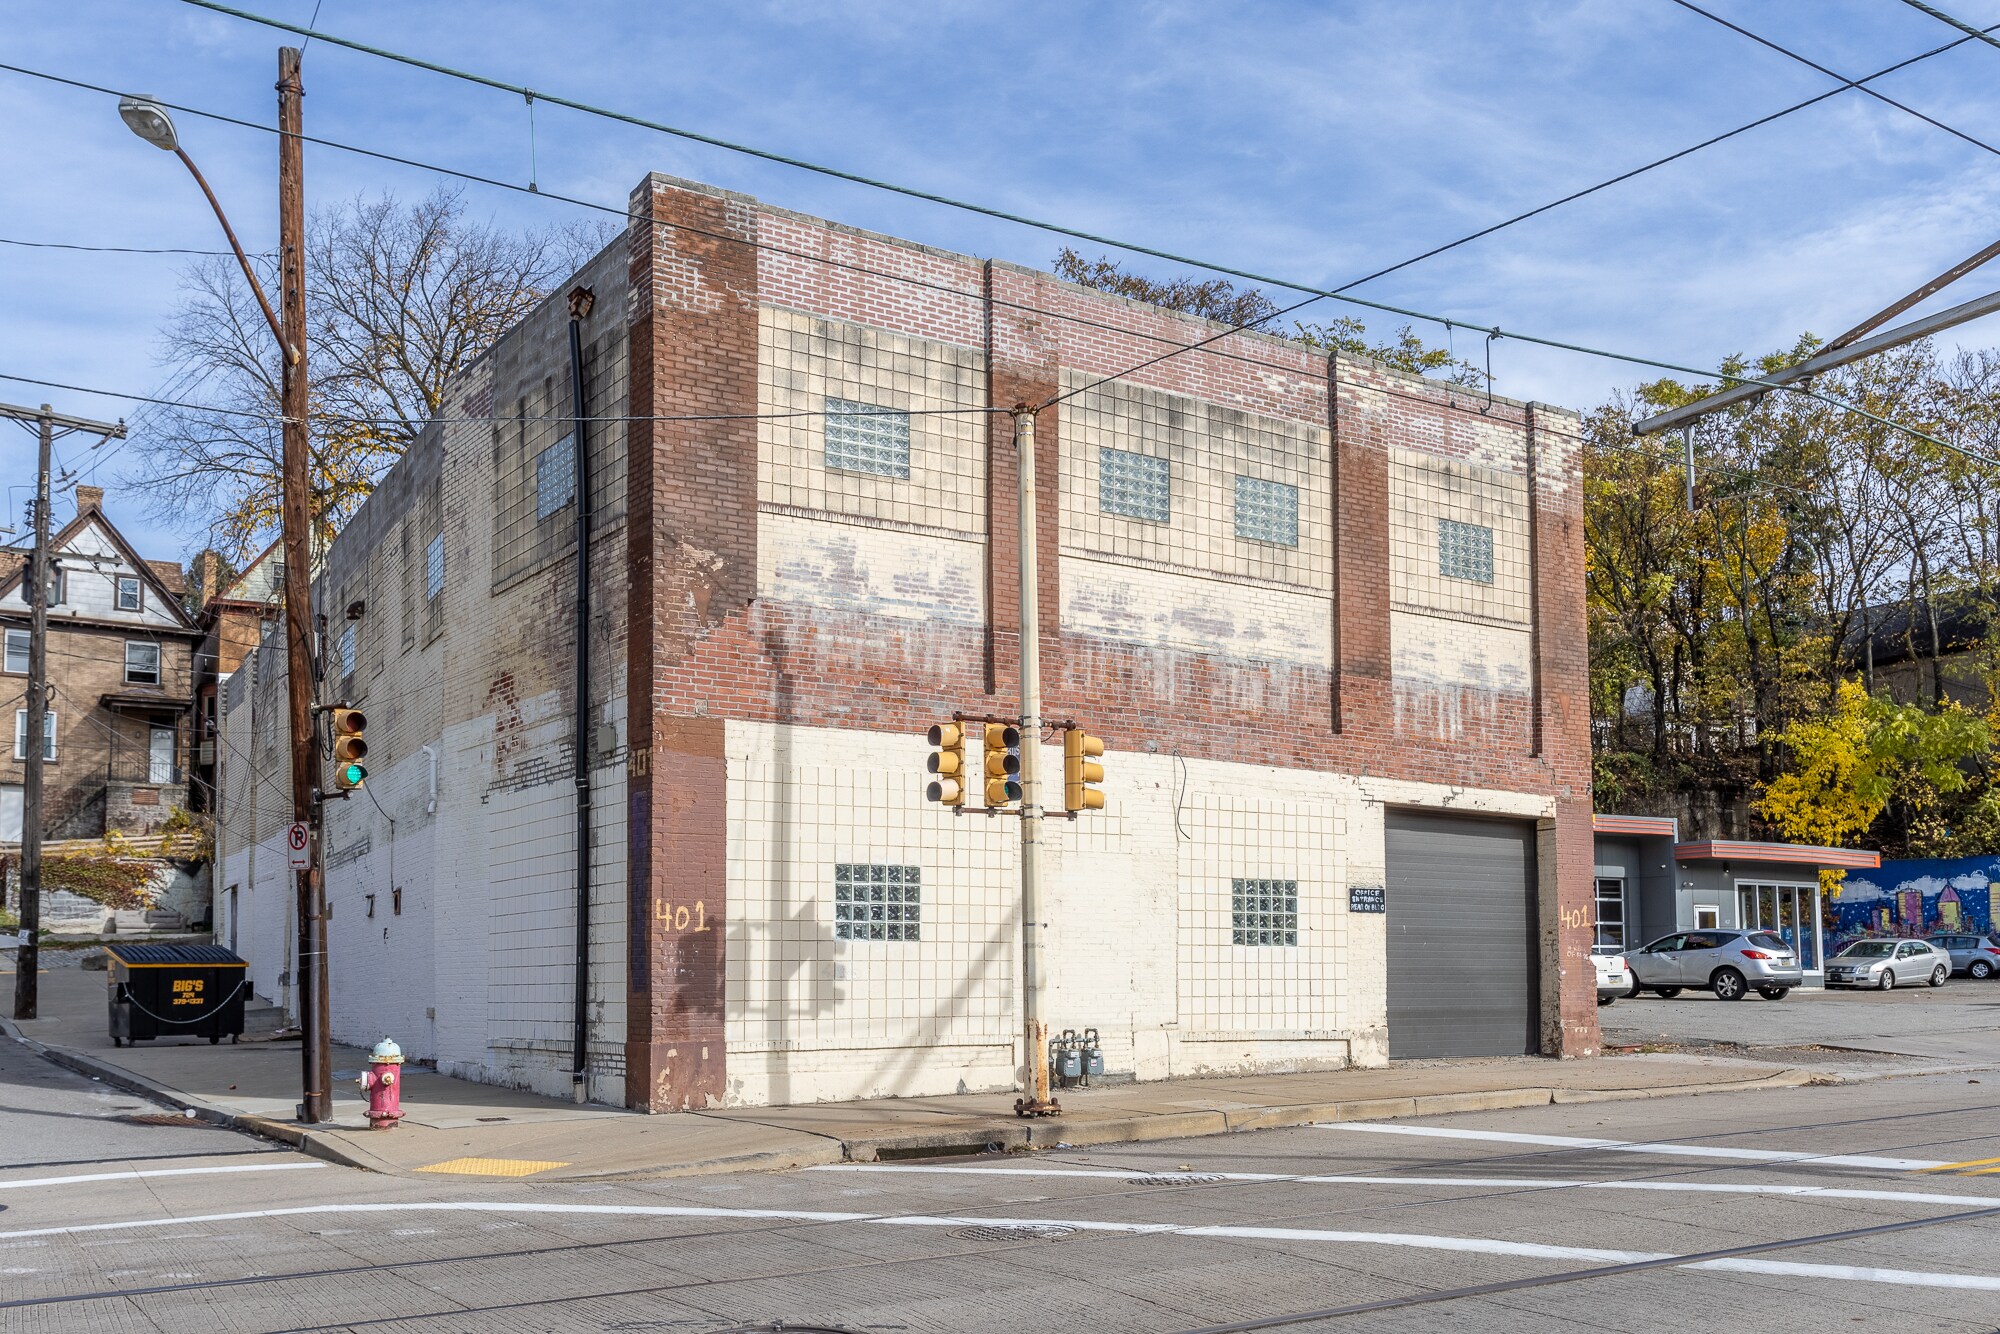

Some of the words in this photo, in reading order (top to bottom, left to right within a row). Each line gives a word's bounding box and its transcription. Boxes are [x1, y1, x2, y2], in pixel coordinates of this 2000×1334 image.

[1354, 889, 1380, 897] OFFICE
[655, 898, 711, 932] 401
[1560, 904, 1592, 930] 401
[172, 980, 204, 992] BIG'S
